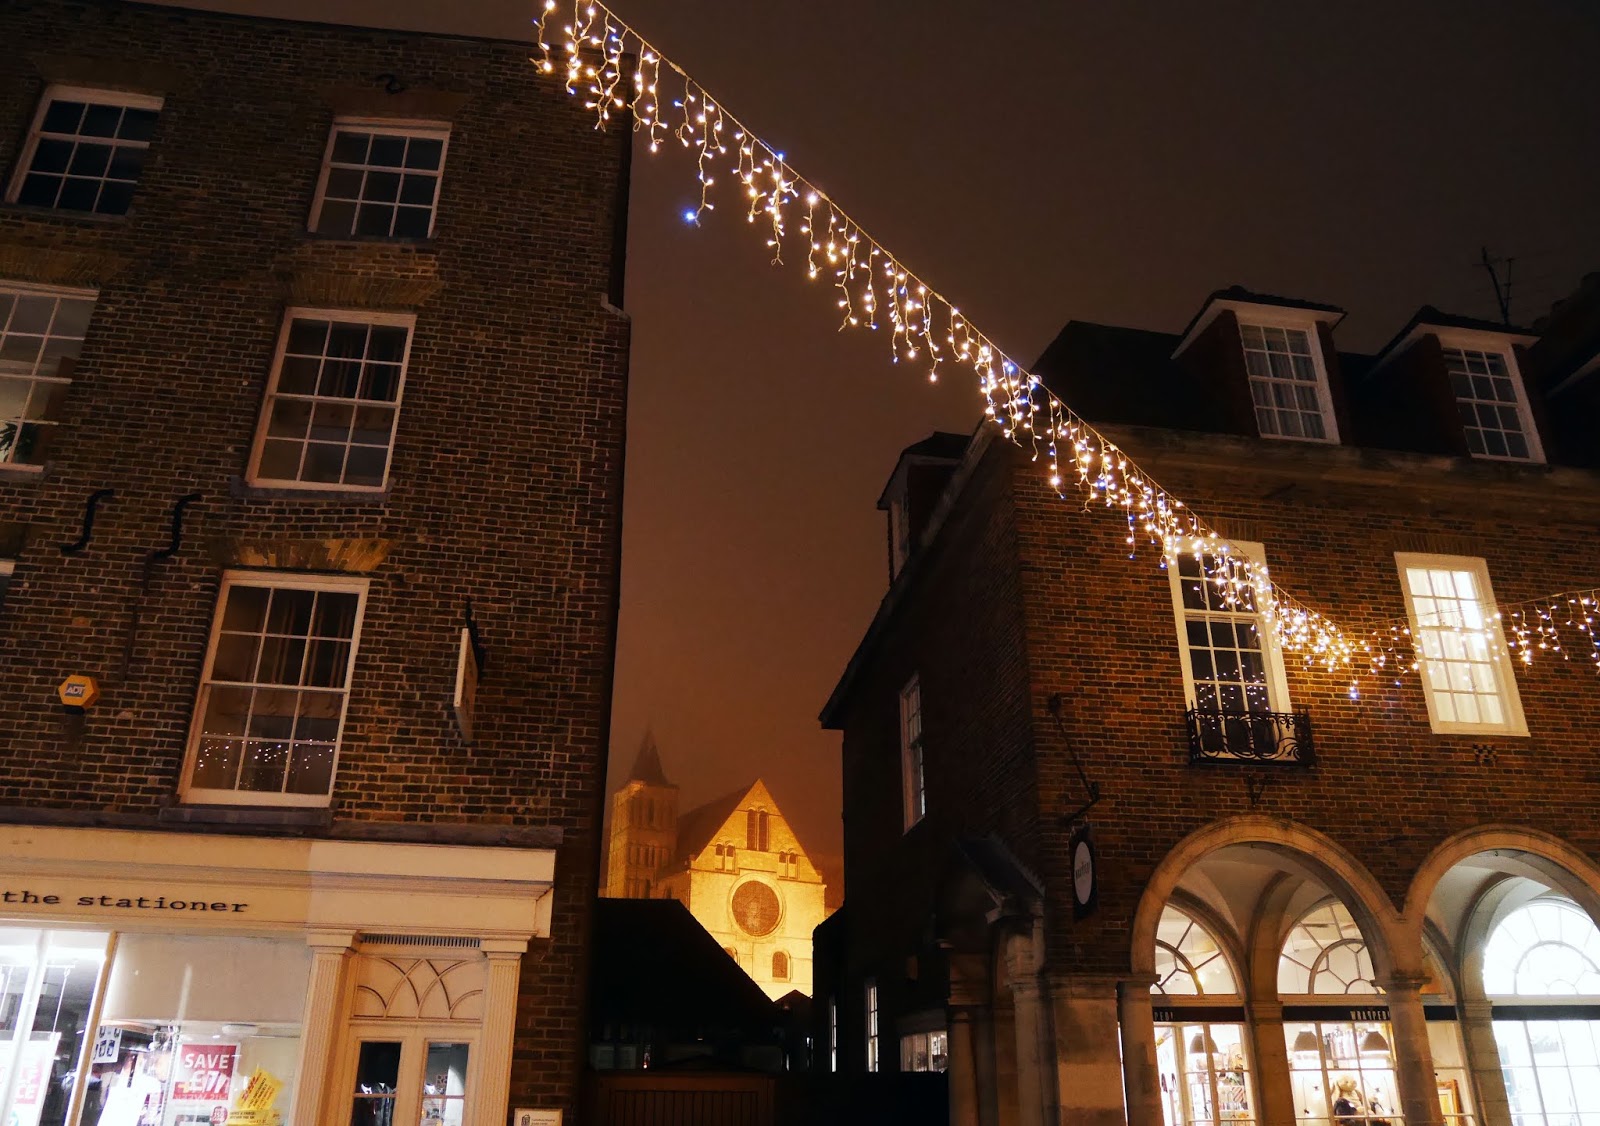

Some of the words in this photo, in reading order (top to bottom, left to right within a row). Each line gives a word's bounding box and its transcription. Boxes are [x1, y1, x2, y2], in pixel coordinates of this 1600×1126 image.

[65, 686, 86, 695] ADT
[1, 890, 60, 904] the
[77, 895, 248, 913] stationer
[184, 1053, 230, 1069] SAVE
